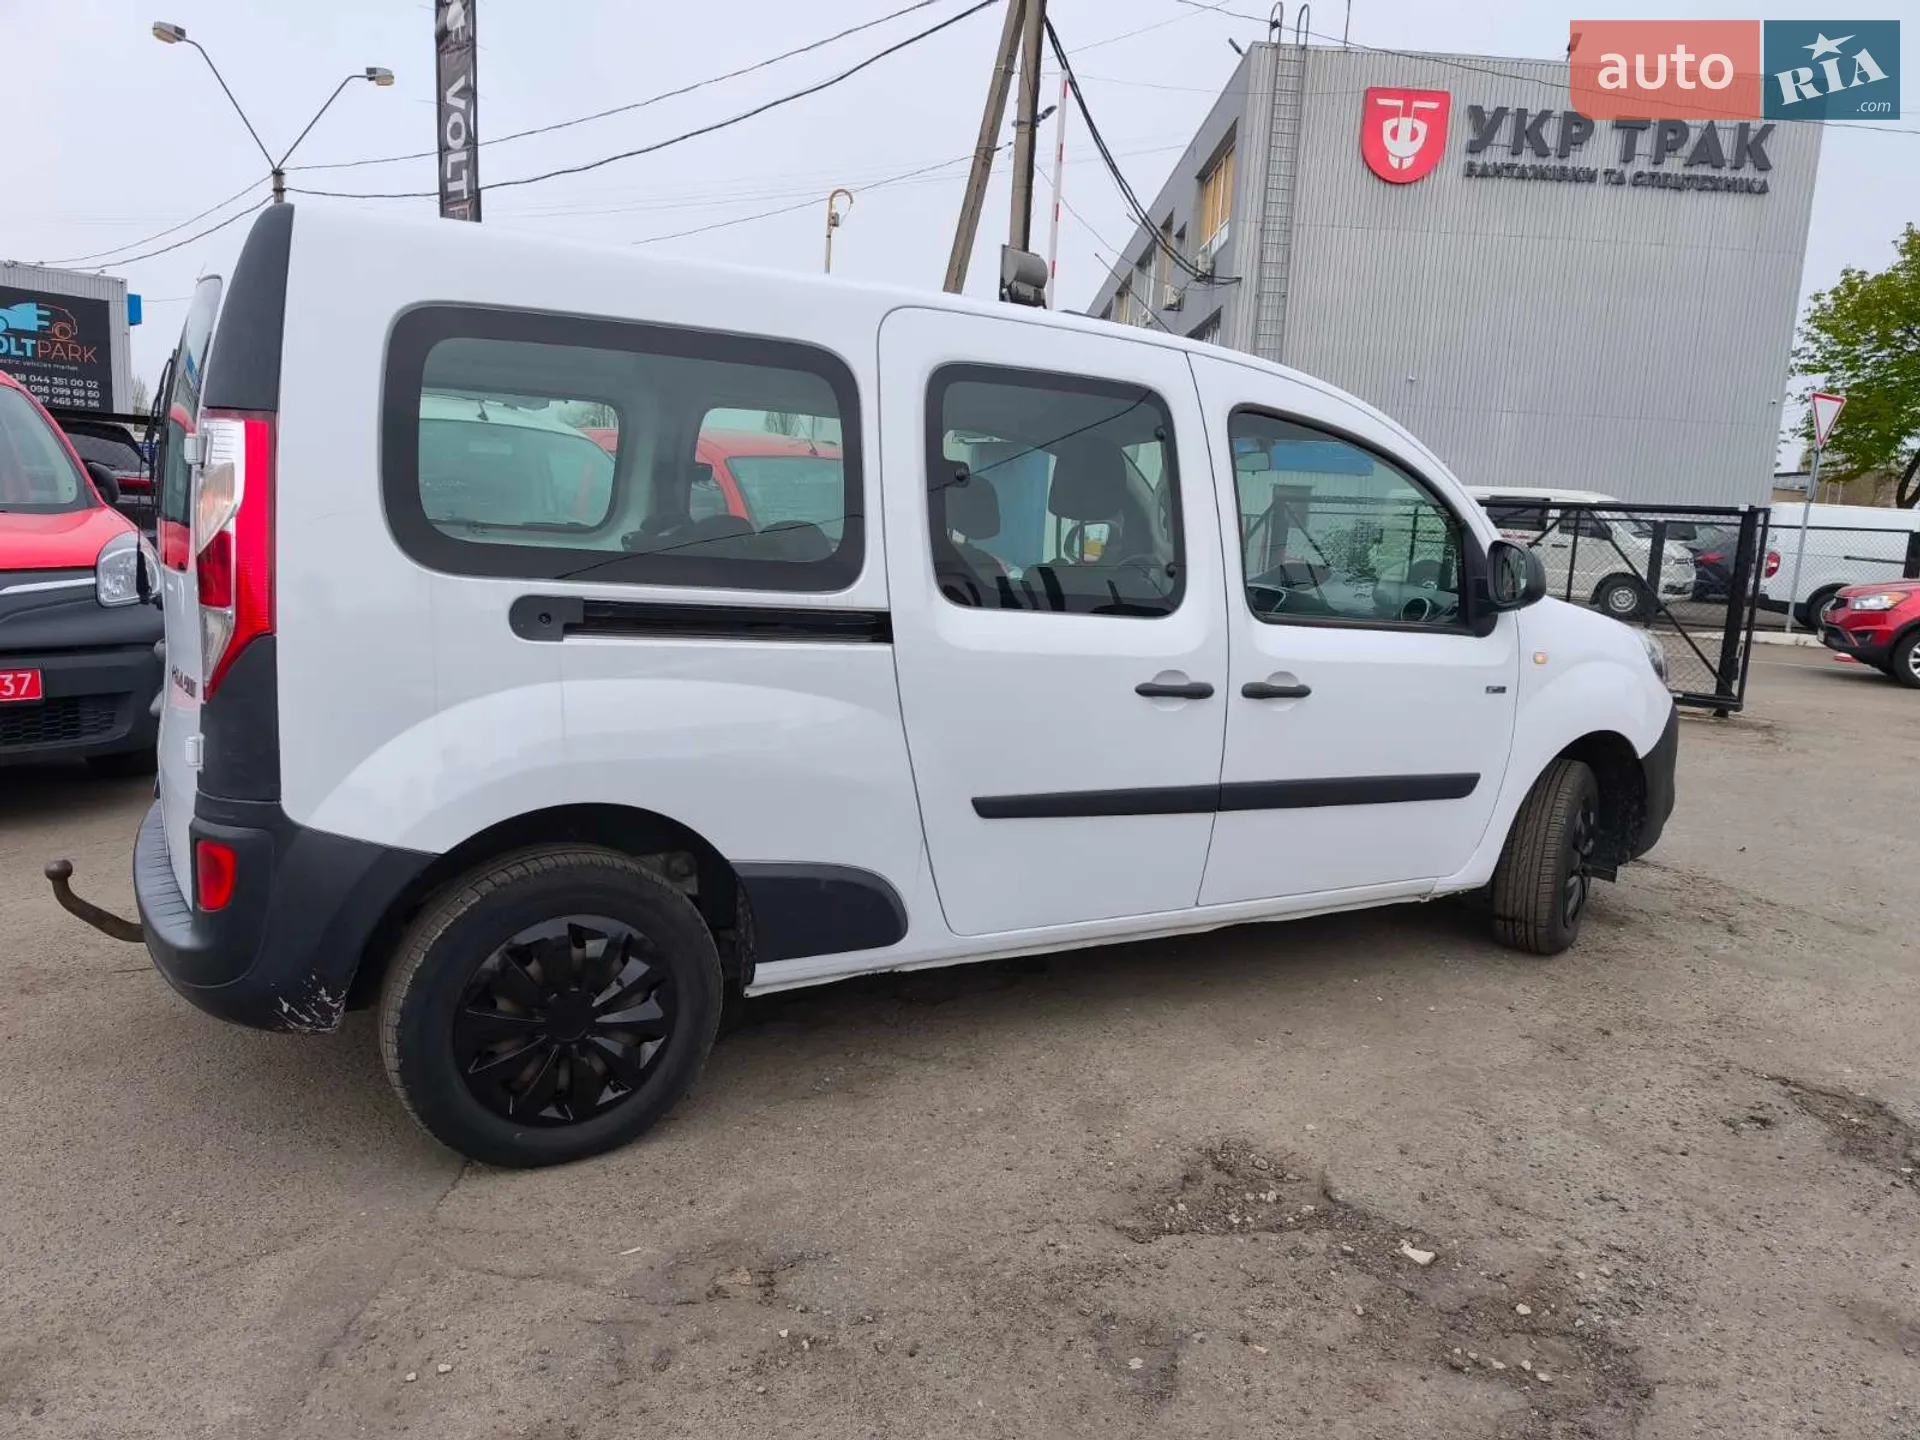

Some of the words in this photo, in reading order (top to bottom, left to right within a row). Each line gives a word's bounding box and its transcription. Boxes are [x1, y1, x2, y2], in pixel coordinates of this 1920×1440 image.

[1466, 104, 1595, 158] УКР
[1611, 115, 1777, 171] ТРАК
[70, 378, 84, 387] 00
[86, 380, 99, 389] 02
[0, 672, 32, 696] 37
